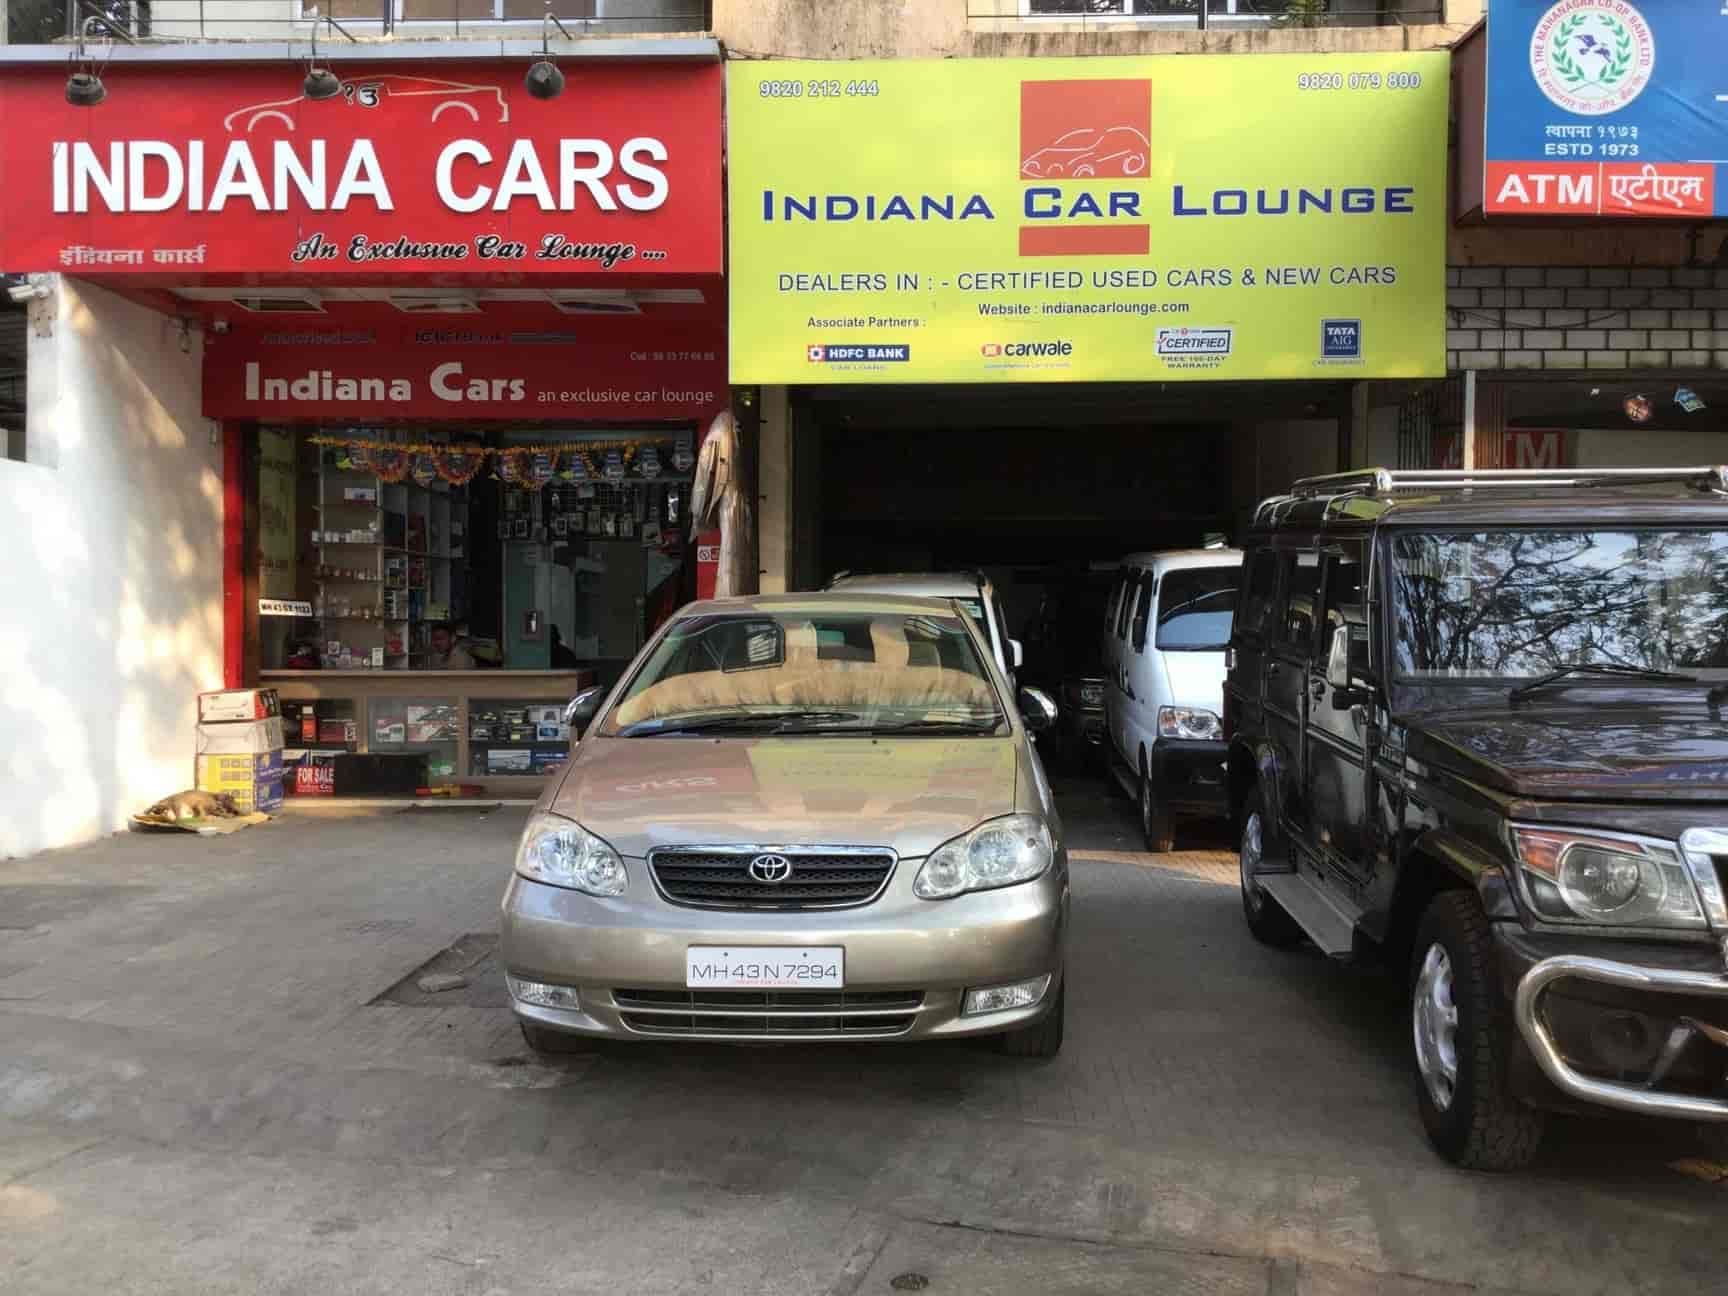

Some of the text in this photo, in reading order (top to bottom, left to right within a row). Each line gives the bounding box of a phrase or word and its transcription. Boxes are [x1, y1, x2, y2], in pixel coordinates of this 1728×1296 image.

[759, 80, 880, 97] 9820 212 444
[1298, 72, 1422, 89] 9820 079 800
[1544, 143, 1640, 157] ESTD 1973
[53, 137, 669, 213] INDIANA CARS
[1495, 174, 1593, 204] ATM
[1608, 164, 1705, 207] एटीएम
[292, 233, 337, 262] An
[347, 234, 468, 261] Exclusive
[474, 234, 526, 260] Car
[535, 233, 635, 269] Lounge
[778, 273, 887, 291] DEALERS
[896, 273, 919, 291] IN
[957, 271, 1083, 290] CERTIFIED
[1092, 270, 1158, 288] USED
[1167, 269, 1232, 287] CARS
[1241, 269, 1257, 286] &
[1265, 267, 1321, 285] NEW
[1329, 266, 1396, 284] CARS
[978, 302, 1031, 315] Website
[1042, 301, 1190, 316] indianacarlounge.com
[807, 316, 865, 327] Associate
[869, 316, 920, 327] Partners
[1327, 327, 1356, 336] TATA
[1004, 340, 1072, 357] carwale
[1166, 337, 1226, 348] CERTIFIED
[829, 348, 904, 359] HDFC BANK
[245, 361, 714, 405] Indiana Cars an exclusive car lounge
[297, 767, 313, 784] FOR
[314, 767, 335, 784] SALE
